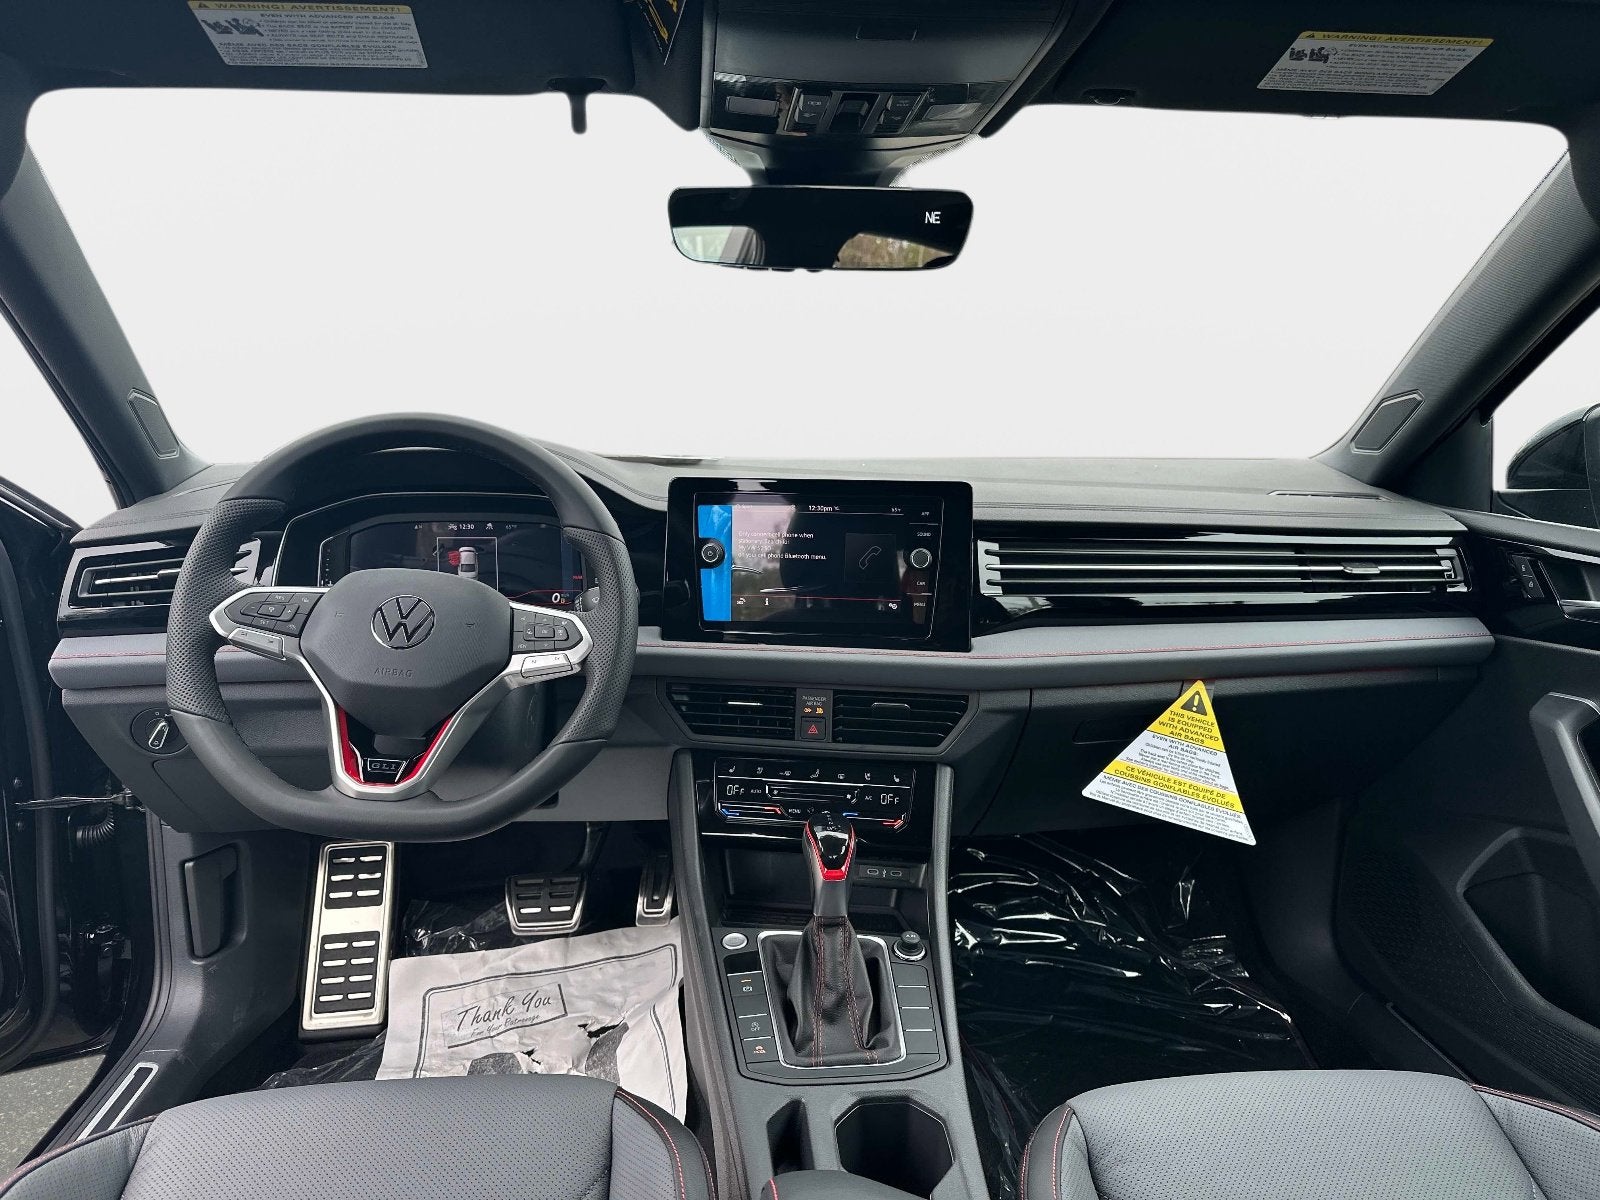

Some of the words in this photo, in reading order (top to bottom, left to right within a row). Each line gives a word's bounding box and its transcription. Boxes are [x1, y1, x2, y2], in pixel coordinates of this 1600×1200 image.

[925, 211, 941, 224] NE
[551, 592, 561, 604] 0
[374, 667, 413, 677] AIRBAG
[1169, 710, 1185, 719] THIS
[1186, 715, 1216, 728] VEHICLE
[1177, 719, 1213, 733] EQUIPPED
[1158, 720, 1178, 730] WITH
[1179, 726, 1220, 742] ADVANCED
[1169, 730, 1183, 738] AIR
[1183, 735, 1205, 745] BAGS
[1152, 734, 1168, 742] EVEN
[1169, 738, 1185, 746] WITH
[1185, 743, 1218, 756] ADVANCED
[371, 762, 396, 770] GLI
[1114, 769, 1152, 784] COUSSINS
[1152, 780, 1201, 799] GONFLABLES
[1201, 794, 1235, 809] ÉVOLUÉS
[1121, 780, 1137, 789] AVEC
[1125, 765, 1136, 773] CE
[1136, 767, 1171, 783] VÉHICULE
[1173, 778, 1187, 788] EST
[1188, 783, 1215, 796] ÉQUIPÉ
[1215, 792, 1227, 800] DE
[457, 996, 515, 1032] Thank
[521, 990, 552, 1012] You
[470, 1027, 485, 1038] For
[486, 1023, 502, 1034] Your
